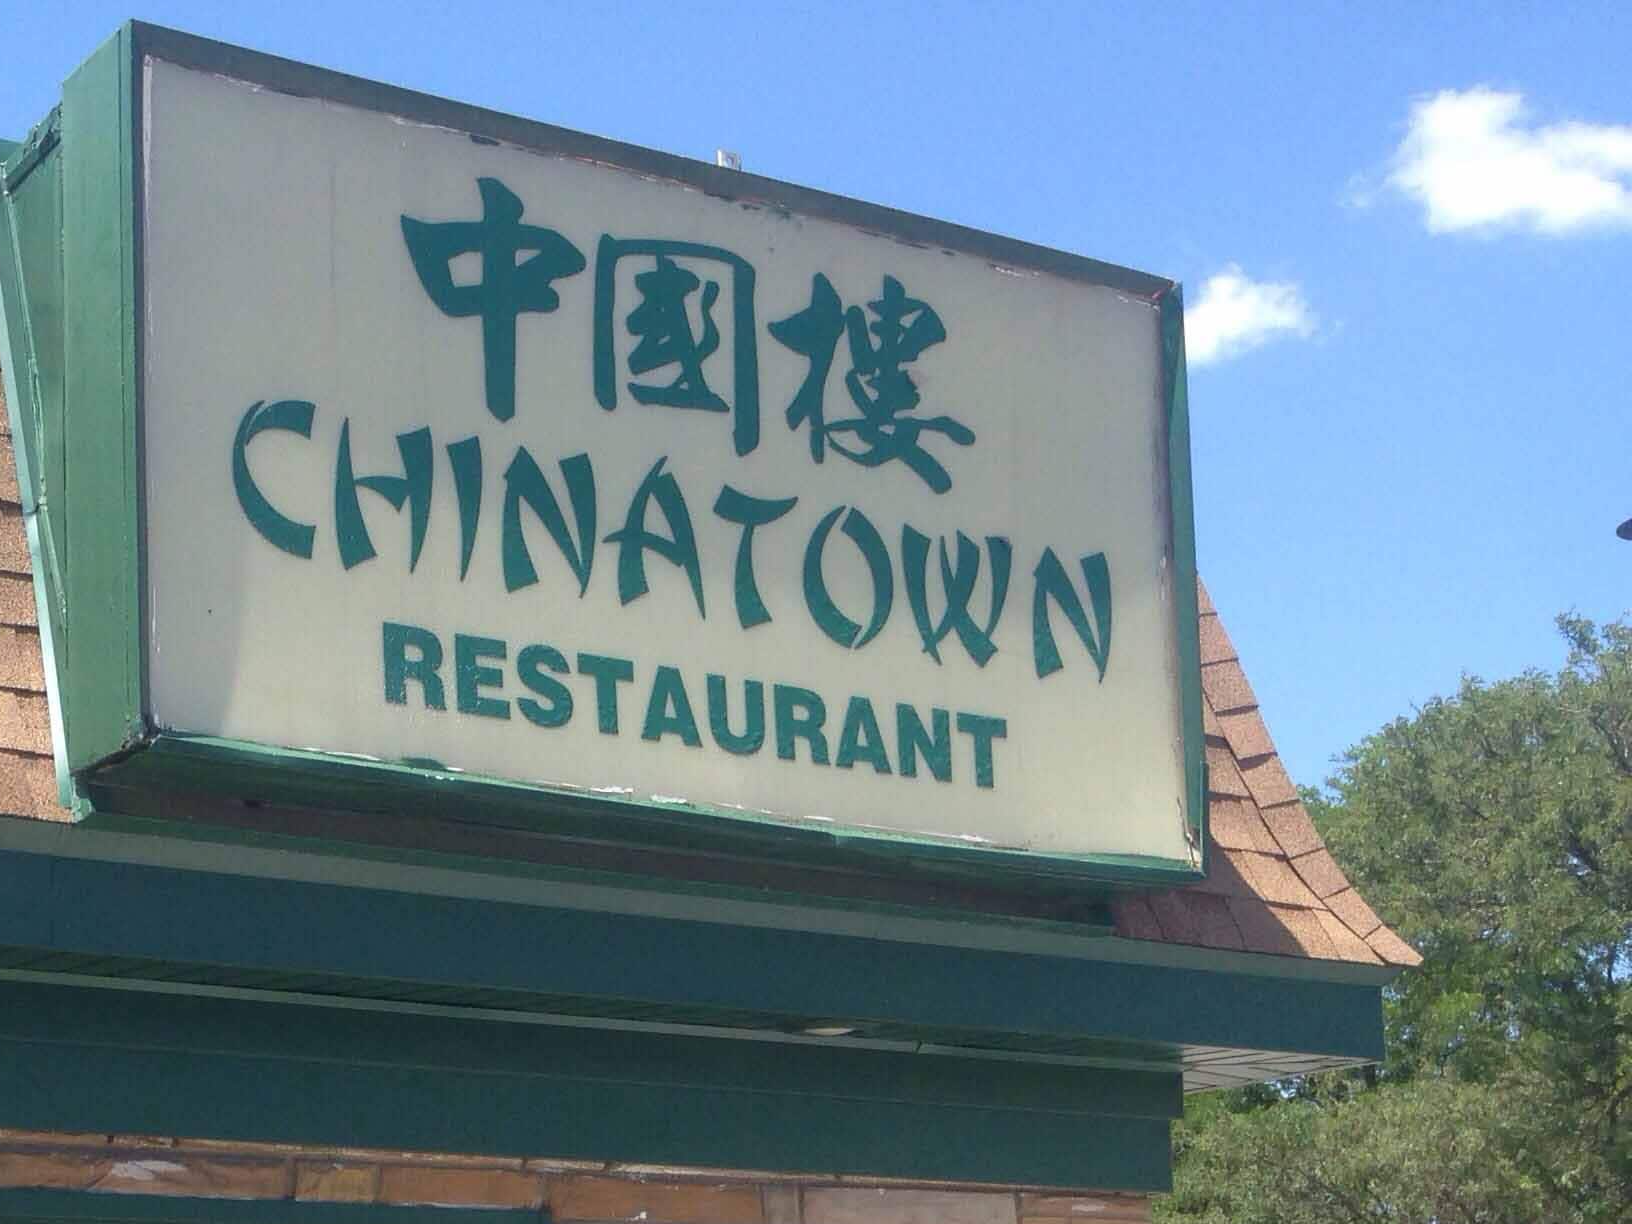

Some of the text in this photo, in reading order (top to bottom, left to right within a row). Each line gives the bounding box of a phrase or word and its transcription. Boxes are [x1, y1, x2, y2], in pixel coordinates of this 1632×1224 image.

[400, 176, 975, 494] 中國樓
[231, 398, 1111, 683] CHINATOWN
[381, 620, 1007, 790] RESTAURANT
